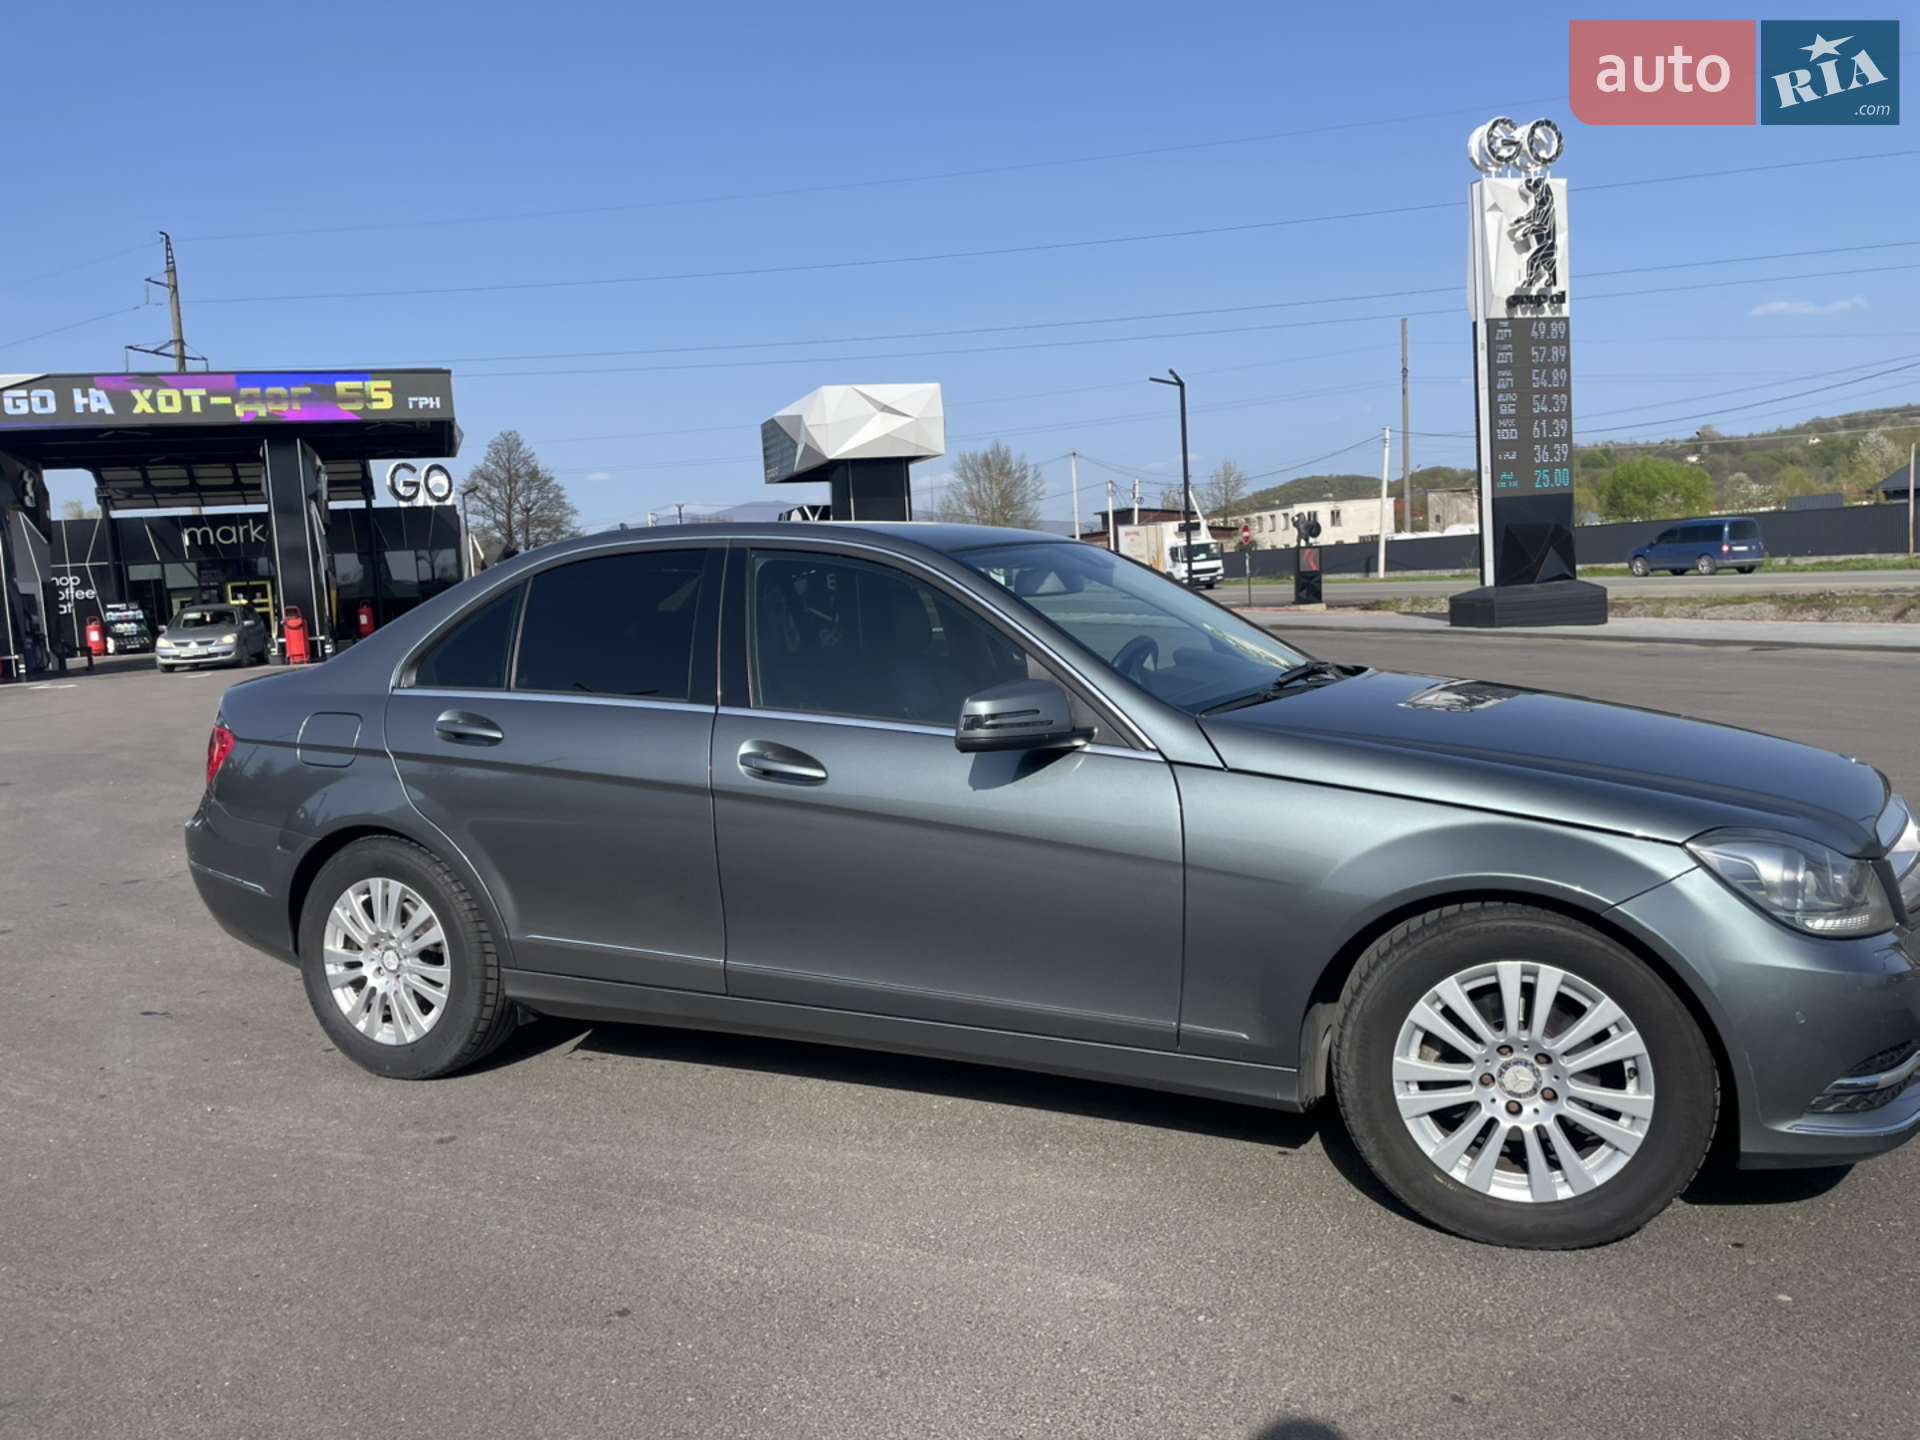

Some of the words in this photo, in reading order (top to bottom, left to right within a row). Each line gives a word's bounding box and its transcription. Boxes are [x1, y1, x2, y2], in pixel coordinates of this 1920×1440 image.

[1485, 116, 1564, 165] GO
[1530, 320, 1567, 340] 49.89
[1531, 345, 1567, 364] 57.89
[1531, 368, 1568, 389] 54.89
[2, 389, 56, 415] GO
[73, 388, 115, 414] НА
[130, 386, 312, 417] ХОТ-ДОГ
[335, 380, 393, 411] 55
[408, 396, 441, 409] ГРН
[1532, 394, 1569, 413] 54.39
[1532, 418, 1569, 438] 61.39
[1533, 443, 1569, 463] 36.39
[387, 461, 454, 503] GO
[1534, 468, 1571, 489] 25.00
[183, 519, 268, 546] mark
